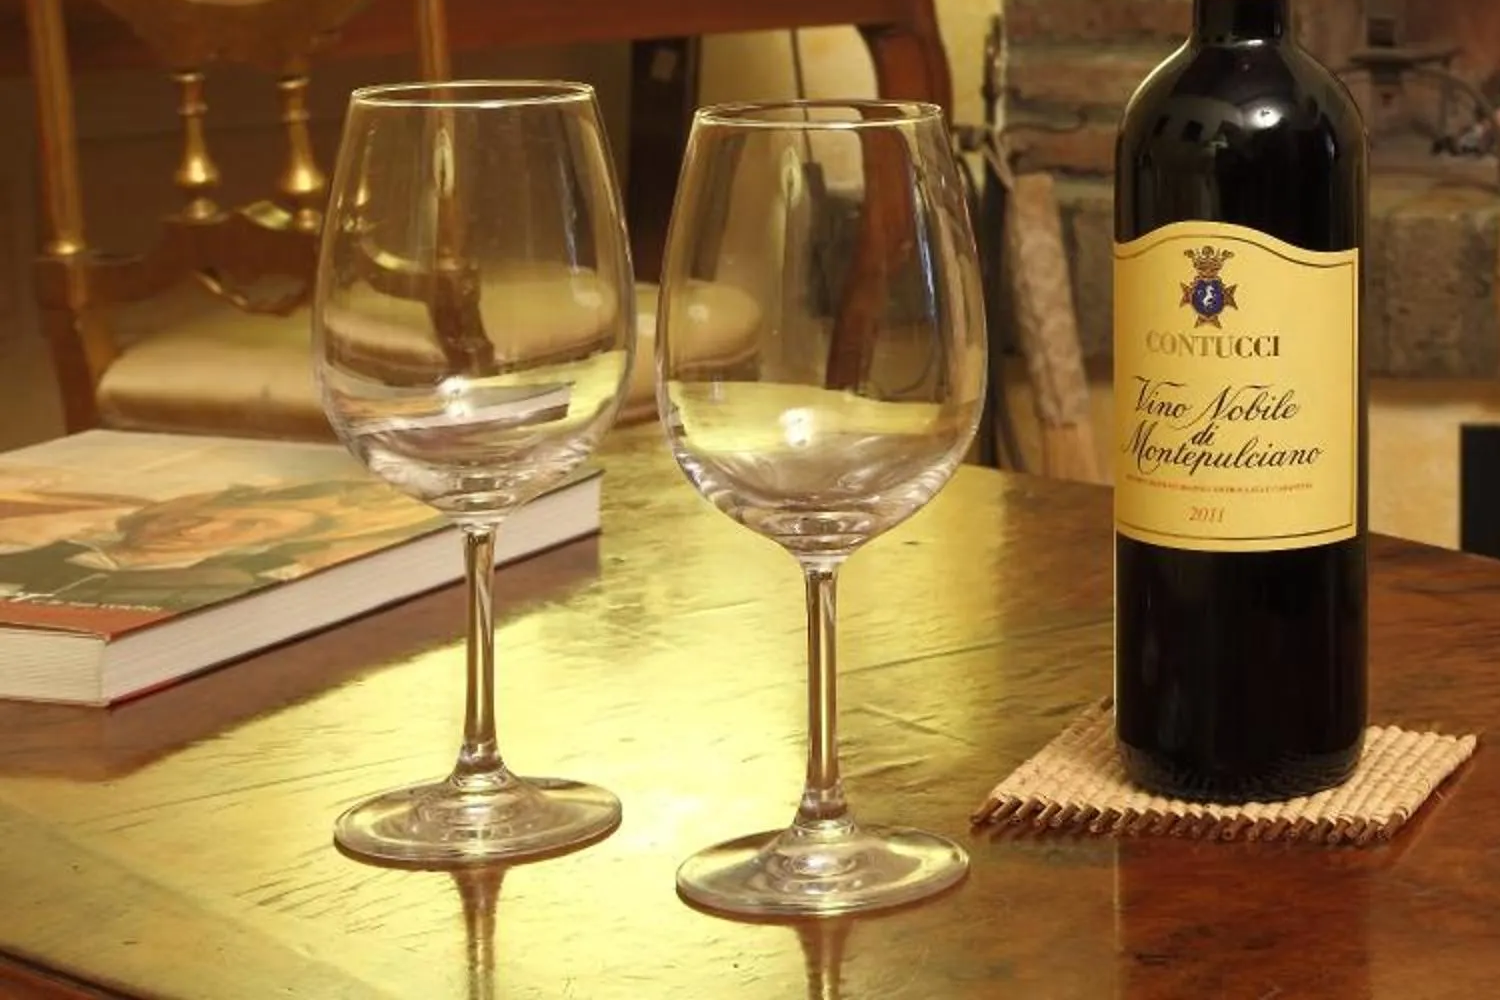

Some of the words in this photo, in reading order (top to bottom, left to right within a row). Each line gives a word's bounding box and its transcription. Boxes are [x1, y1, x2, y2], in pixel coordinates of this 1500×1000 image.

[1146, 331, 1281, 358] CONTUCCI
[1134, 375, 1189, 418] Vino
[1176, 385, 1301, 430] Nobile
[1125, 419, 1323, 475] Montepulciano
[1191, 422, 1220, 446] di
[1188, 506, 1225, 523] 2011
